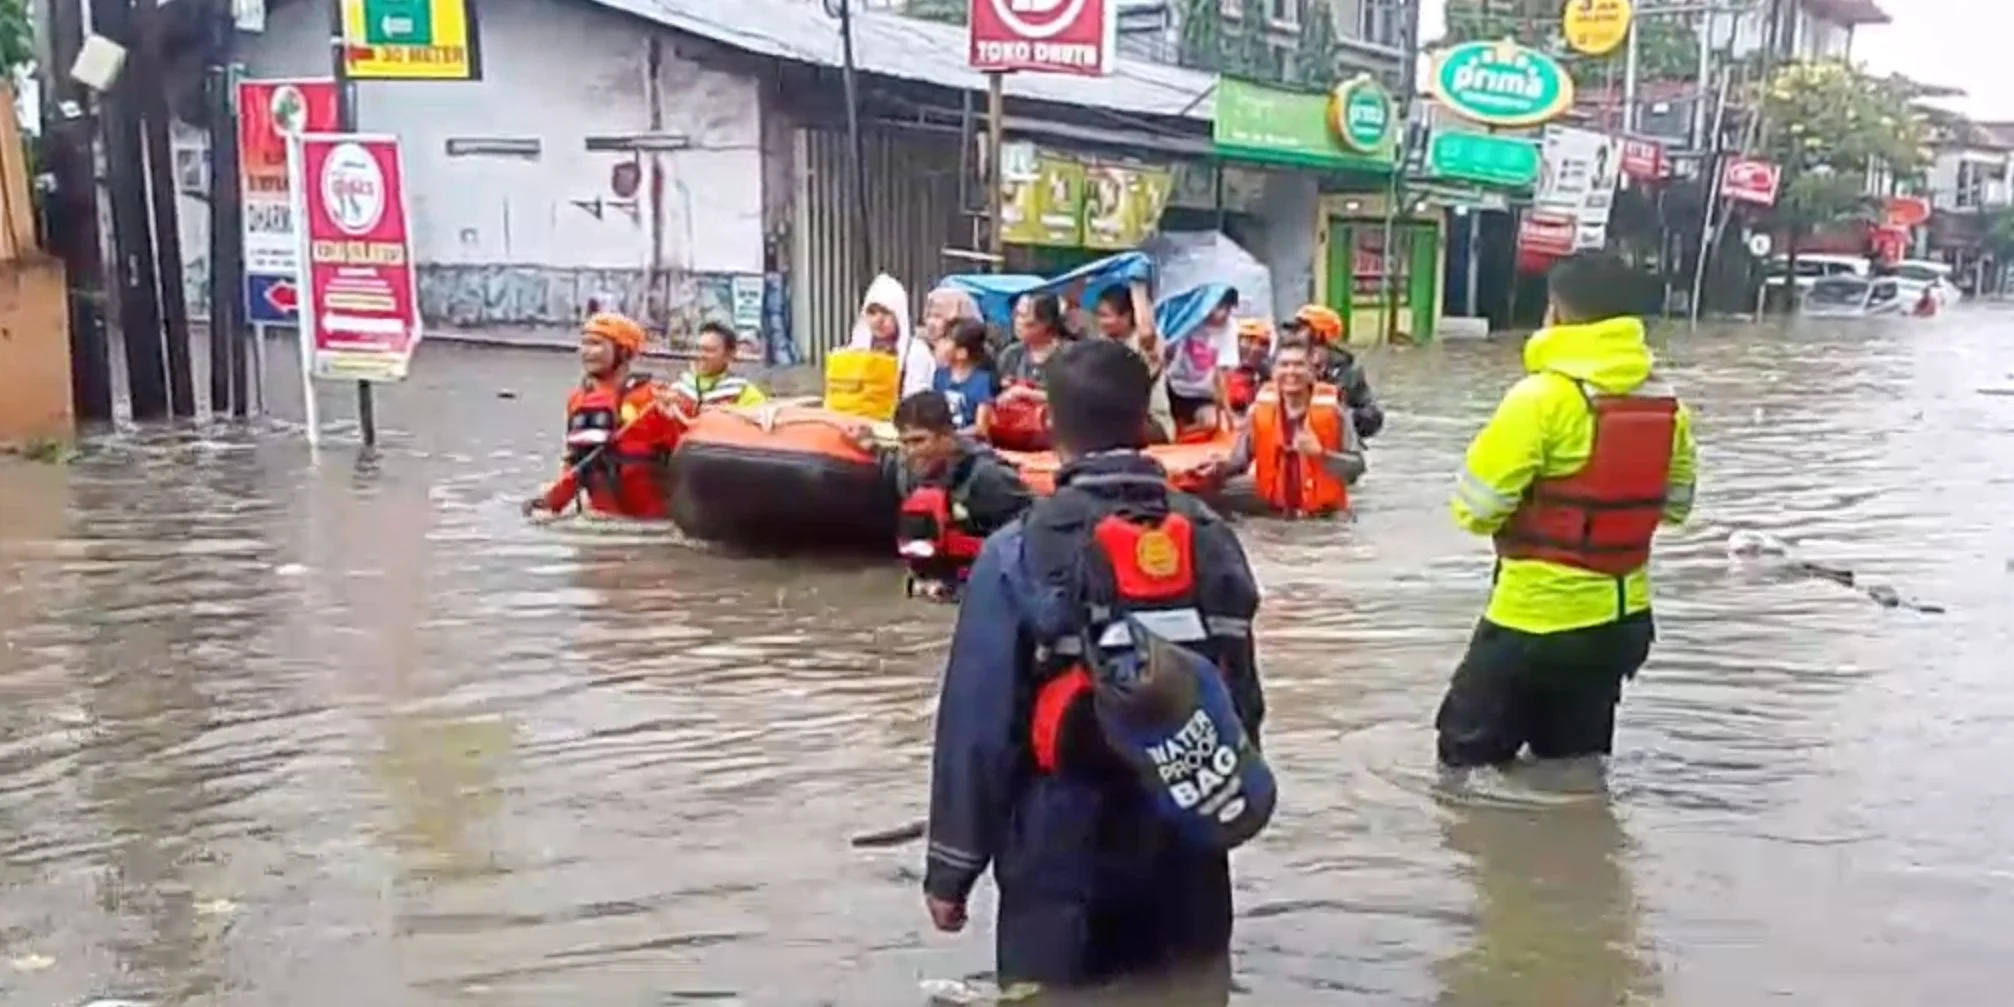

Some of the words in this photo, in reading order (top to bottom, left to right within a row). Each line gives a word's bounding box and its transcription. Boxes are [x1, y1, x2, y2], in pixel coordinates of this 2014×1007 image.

[977, 41, 1030, 62] TOKO
[1452, 62, 1545, 98] prima
[1145, 709, 1214, 764] WATER
[1158, 730, 1219, 784] PROOF
[1169, 745, 1238, 809] BAG
